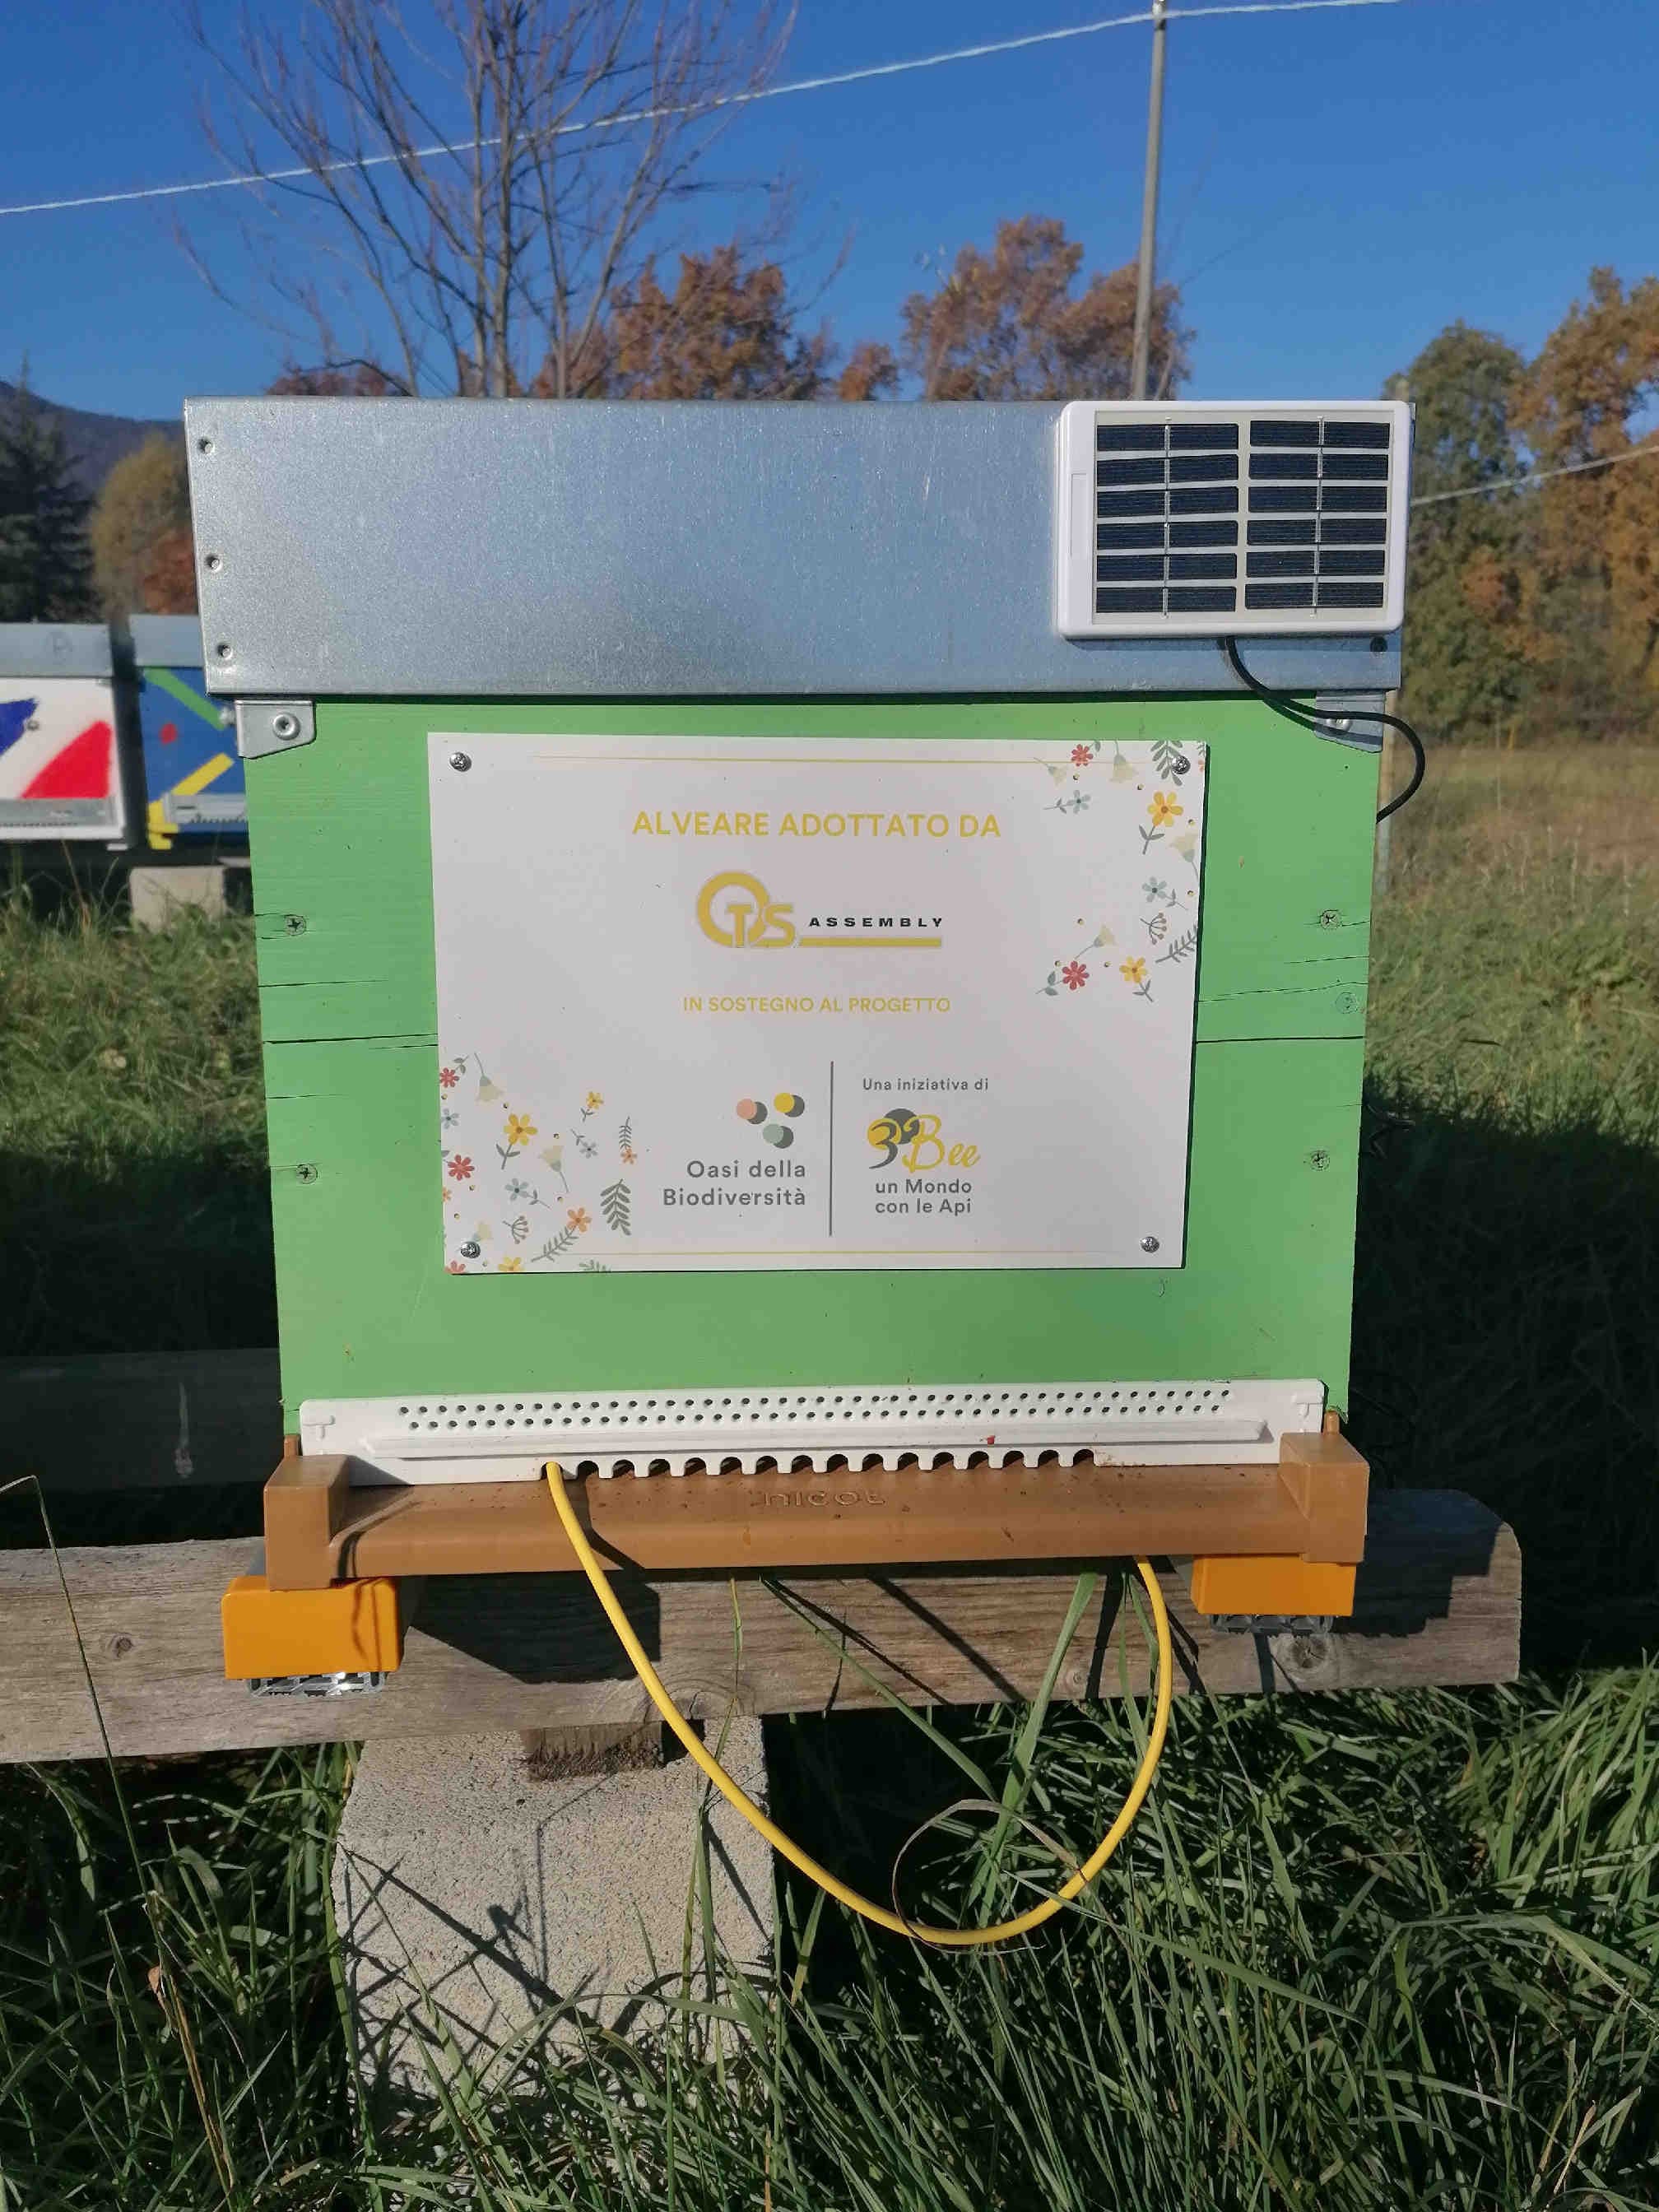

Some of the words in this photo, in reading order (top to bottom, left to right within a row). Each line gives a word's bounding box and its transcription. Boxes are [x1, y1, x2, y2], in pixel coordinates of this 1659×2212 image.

[632, 811, 769, 836] ALVEARE
[778, 812, 950, 838] ADOTTATO
[959, 814, 1001, 839] DA
[808, 917, 942, 928] ASSEMBLY
[684, 997, 703, 1011] IN
[709, 997, 814, 1013] SOSTEGNO
[820, 997, 843, 1013] AL
[848, 997, 950, 1014] PROGETTO
[862, 1077, 892, 1091] Una
[897, 1077, 969, 1091] iniziativa
[974, 1077, 989, 1091] di
[686, 1159, 739, 1178] Oasi
[749, 1159, 806, 1178] della
[875, 1182, 898, 1194] un
[905, 1178, 973, 1195] Mondo
[663, 1187, 806, 1206] Biodiversità
[875, 1201, 909, 1214] con
[916, 1198, 933, 1214] le
[939, 1198, 972, 1217] Api
